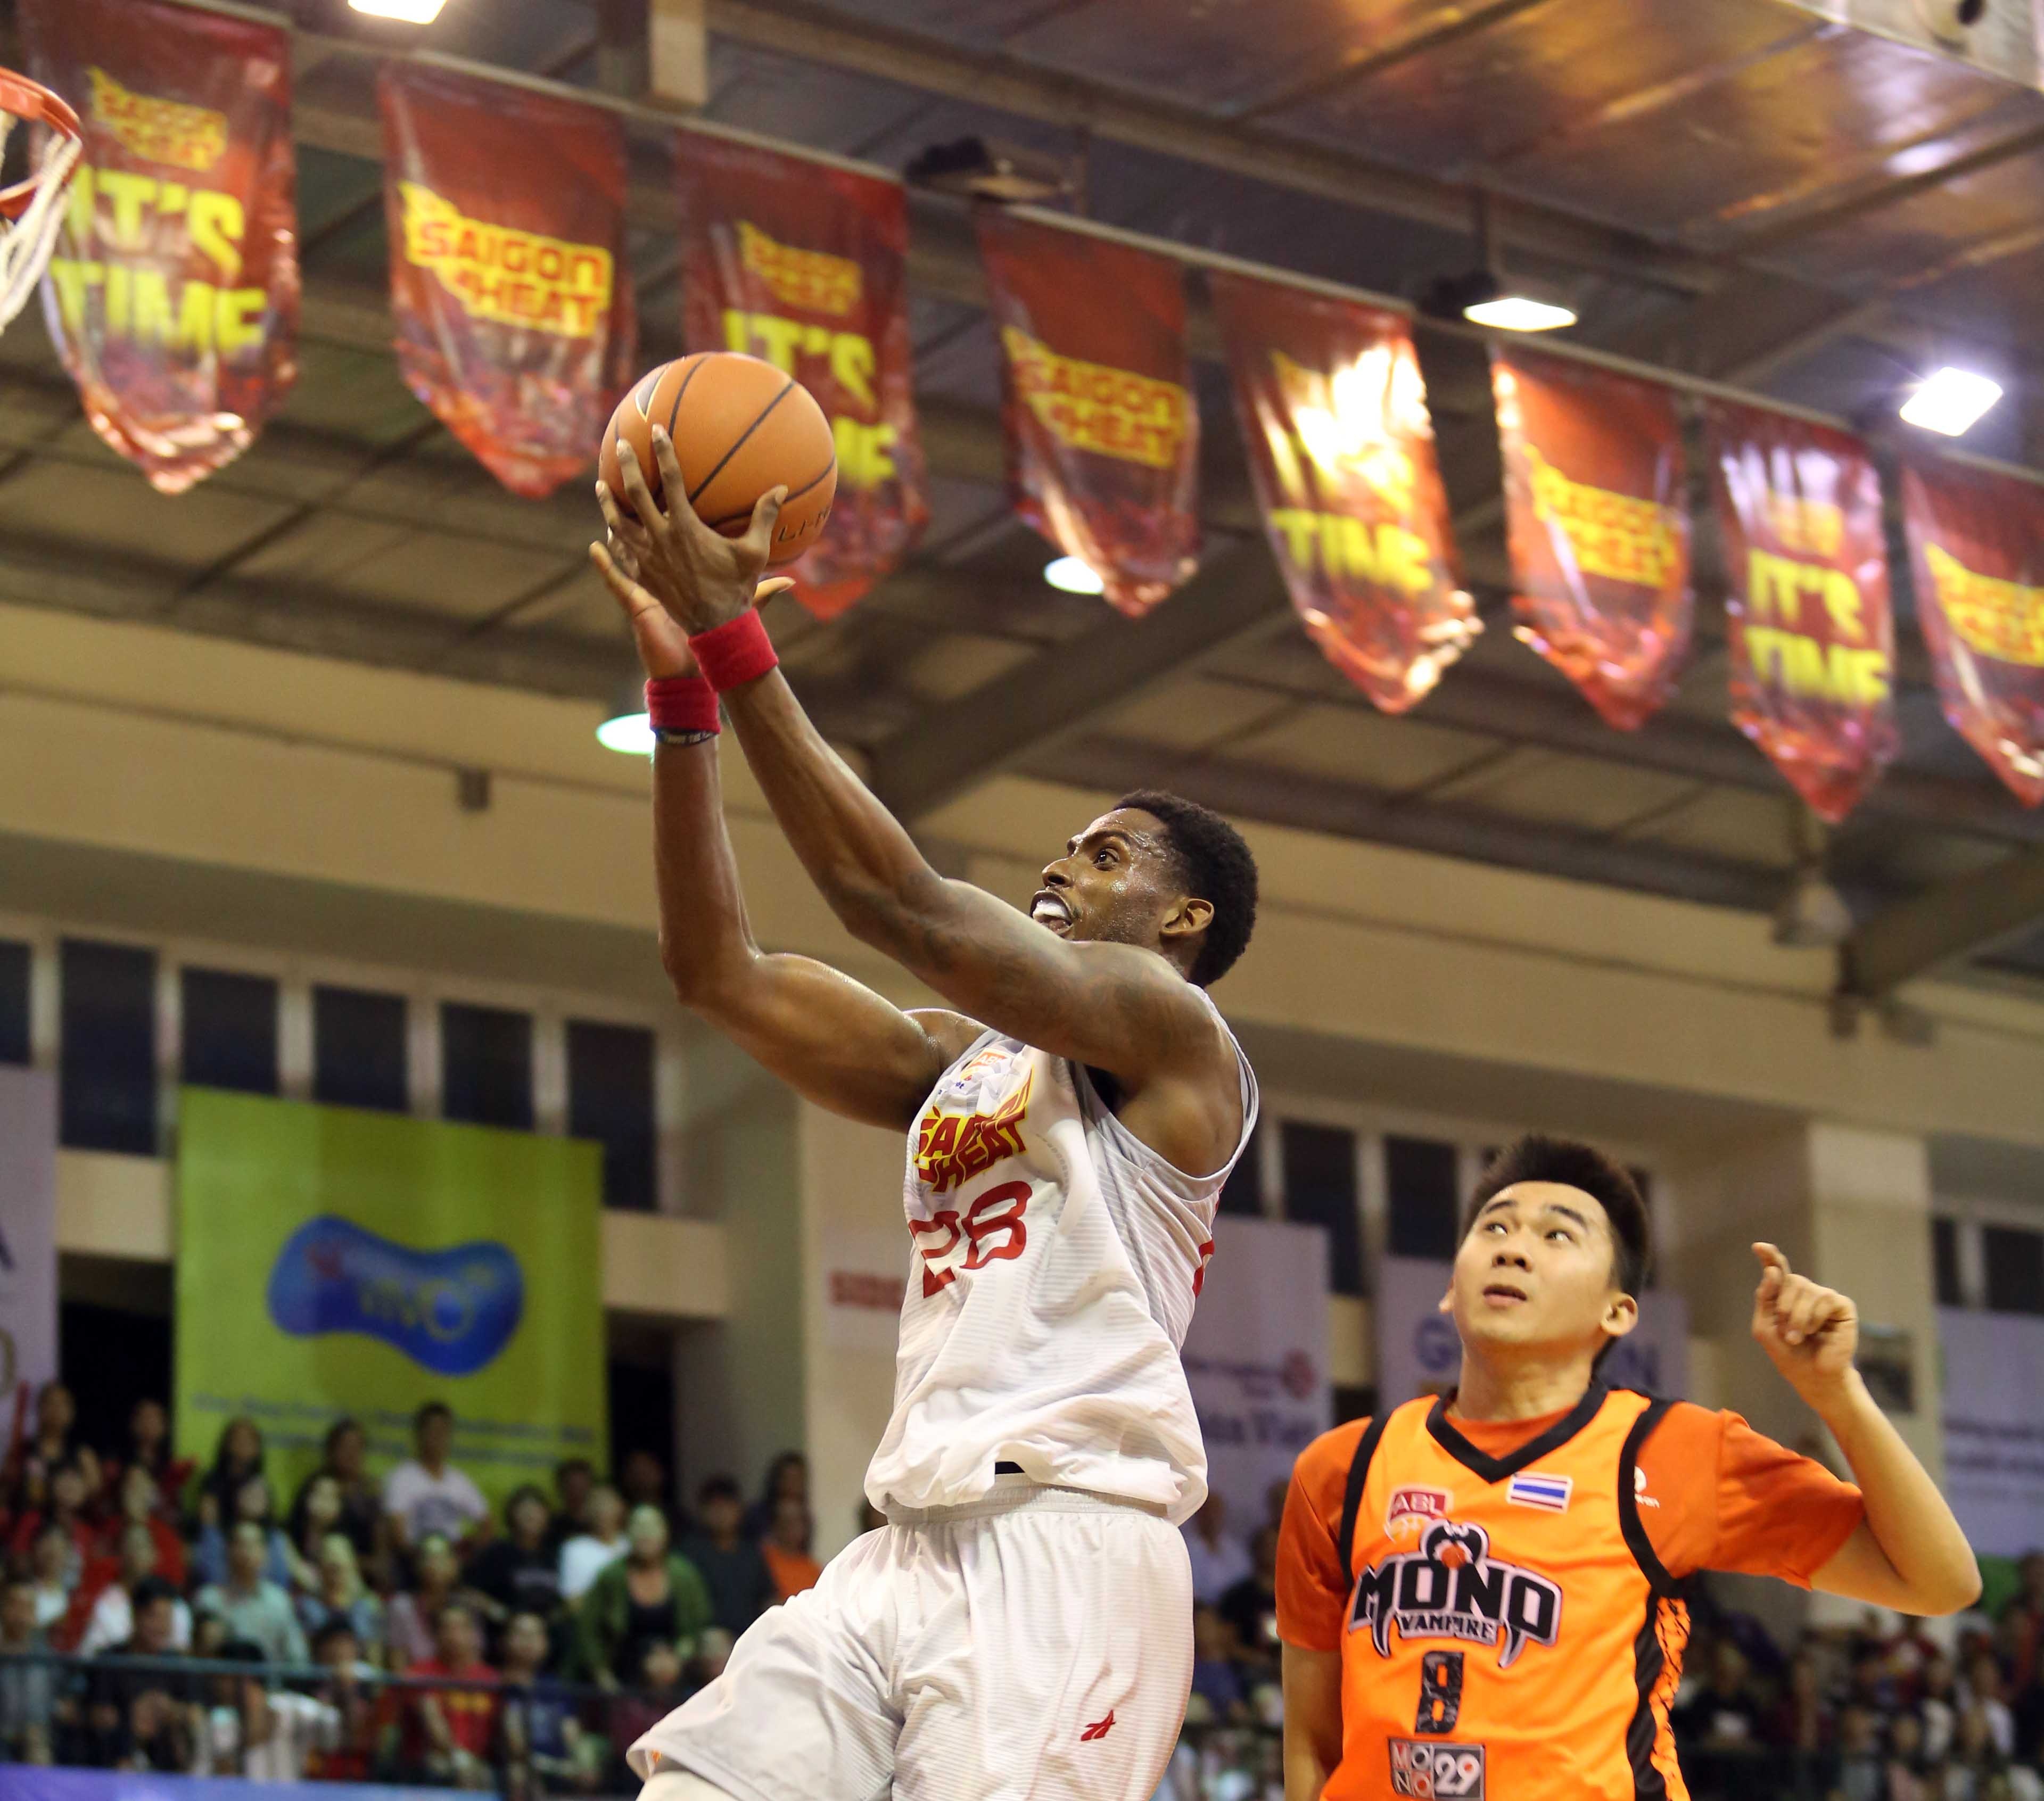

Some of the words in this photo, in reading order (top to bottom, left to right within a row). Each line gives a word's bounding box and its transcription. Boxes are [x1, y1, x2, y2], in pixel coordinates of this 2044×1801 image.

[65, 164, 244, 278] IT'S
[417, 220, 604, 287] SAIGON
[52, 258, 268, 357] TIME
[457, 269, 597, 333] HEAT
[1271, 508, 1433, 595] TIME
[1749, 548, 1867, 643] IT'S
[920, 1108, 1027, 1193] HEAT
[909, 1180, 1033, 1299] 28
[1389, 1492, 1445, 1519] ABL
[1349, 1555, 1563, 1663] MONO
[1398, 1612, 1497, 1639] VAMPIRE
[1414, 1651, 1464, 1734] 8
[1434, 1752, 1481, 1796] 29
